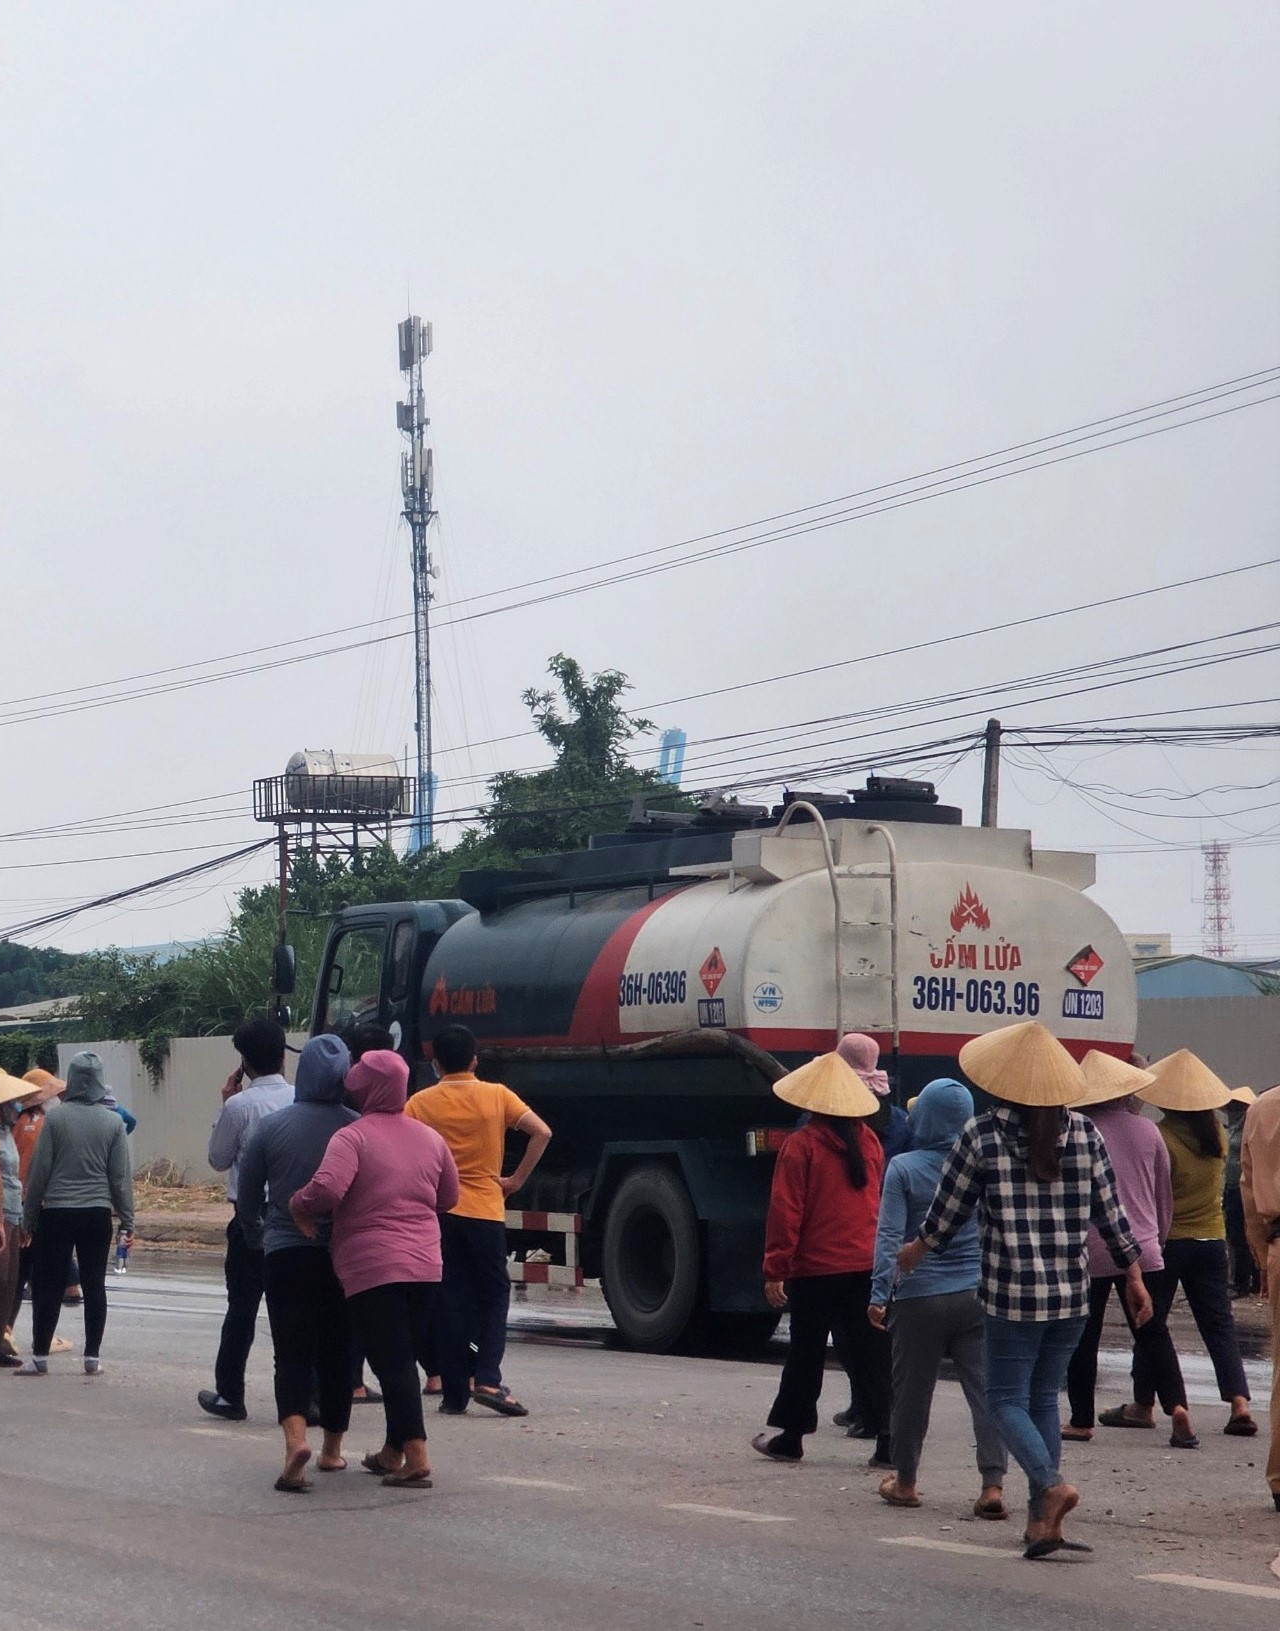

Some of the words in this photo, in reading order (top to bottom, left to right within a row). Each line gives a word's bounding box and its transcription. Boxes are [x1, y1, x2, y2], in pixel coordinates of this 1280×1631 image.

[929, 935, 977, 969] CẤM
[984, 936, 1022, 970] LỬA
[618, 970, 687, 1007] 36H-06396
[761, 986, 776, 996] VN
[912, 975, 1040, 1016] 36H-063.96
[1064, 992, 1079, 1015] UN
[1080, 993, 1102, 1016] 1203
